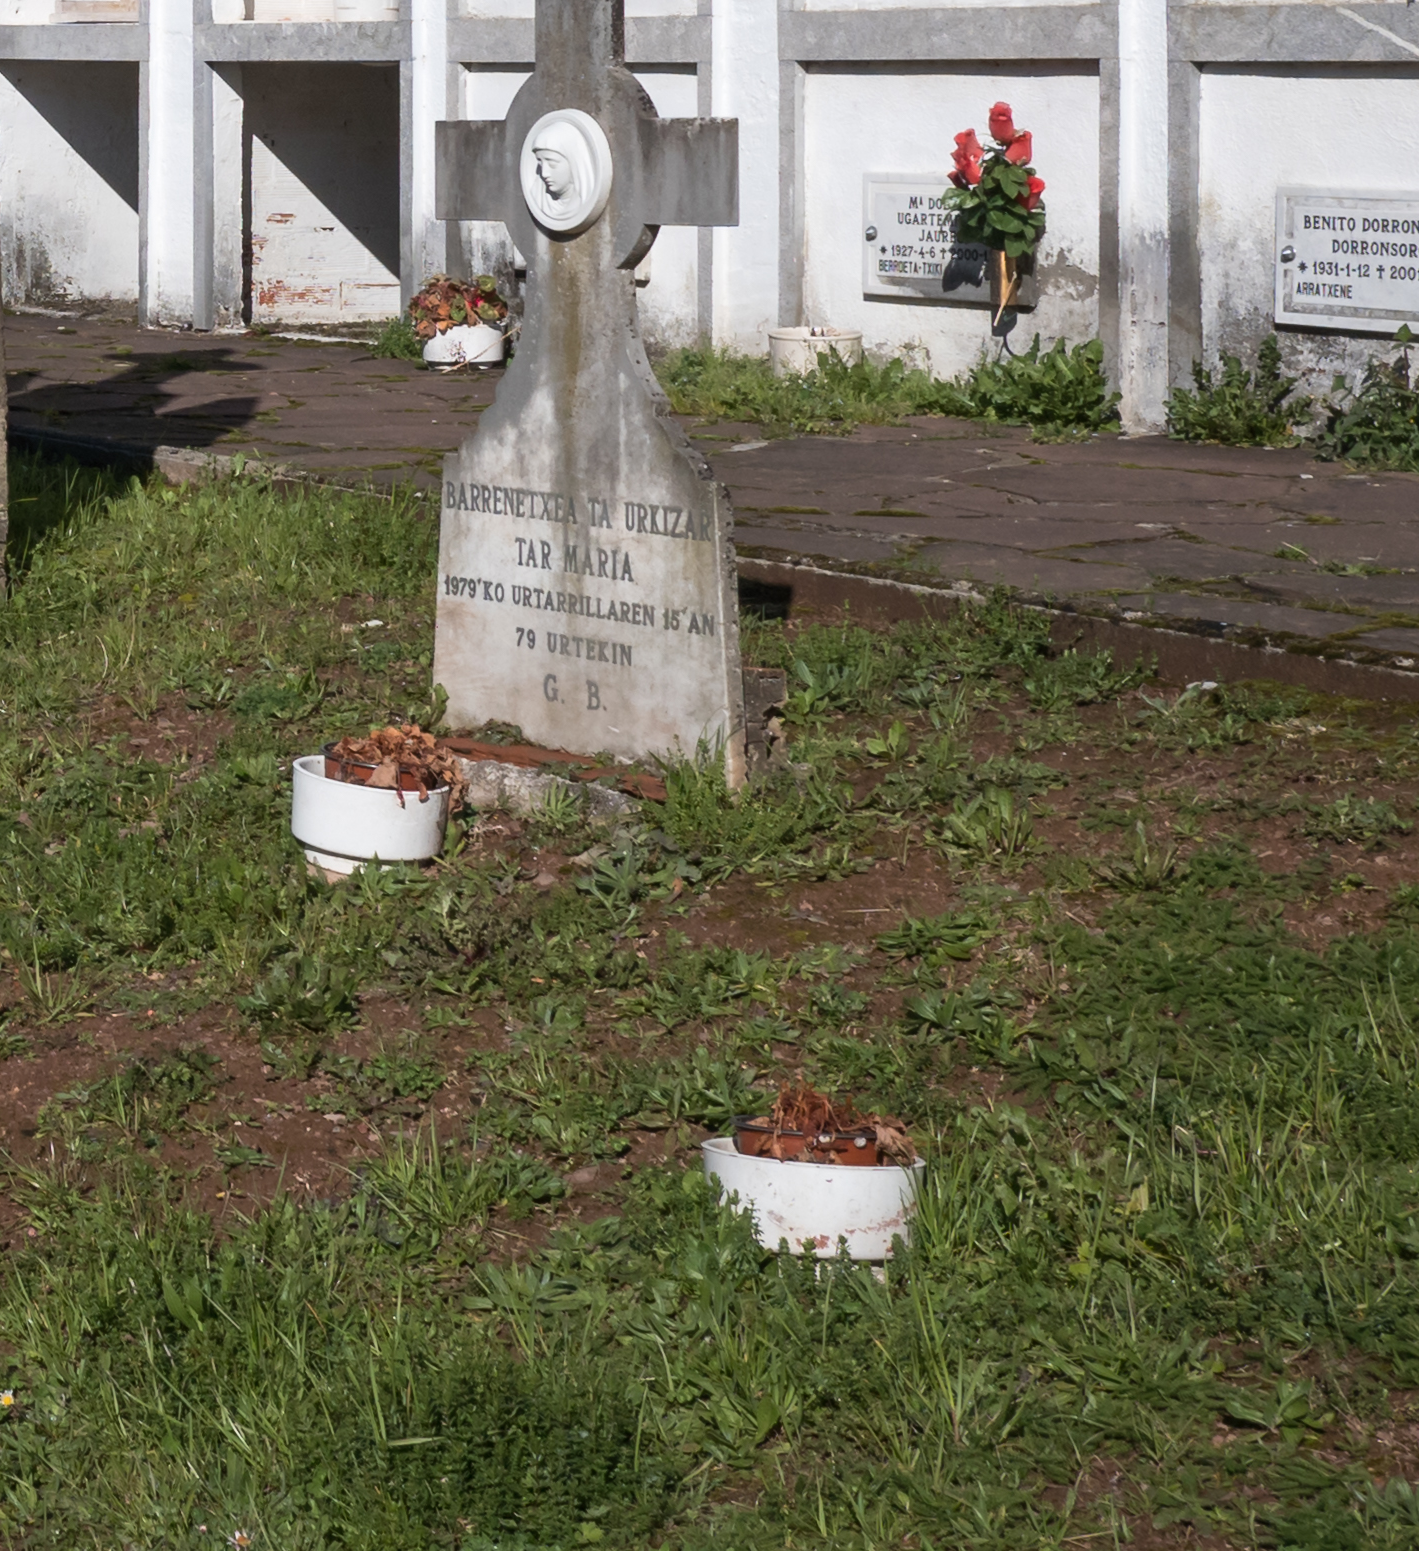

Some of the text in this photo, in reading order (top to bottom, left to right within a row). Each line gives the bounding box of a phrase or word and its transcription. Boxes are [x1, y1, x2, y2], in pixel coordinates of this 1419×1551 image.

[1303, 215, 1419, 235] BENITO DORRON
[891, 245, 936, 259] 1927-4-6
[1331, 239, 1419, 259] DORRONSOR
[1312, 262, 1419, 282] 1931-1-12 200
[1296, 281, 1353, 298] ARRATXENE
[446, 481, 711, 542] BARRENETXEA TA URKIZAR
[515, 537, 552, 570] TAR
[511, 585, 655, 627] URTARRILLAREN
[516, 627, 633, 667] 79 URTEKIN
